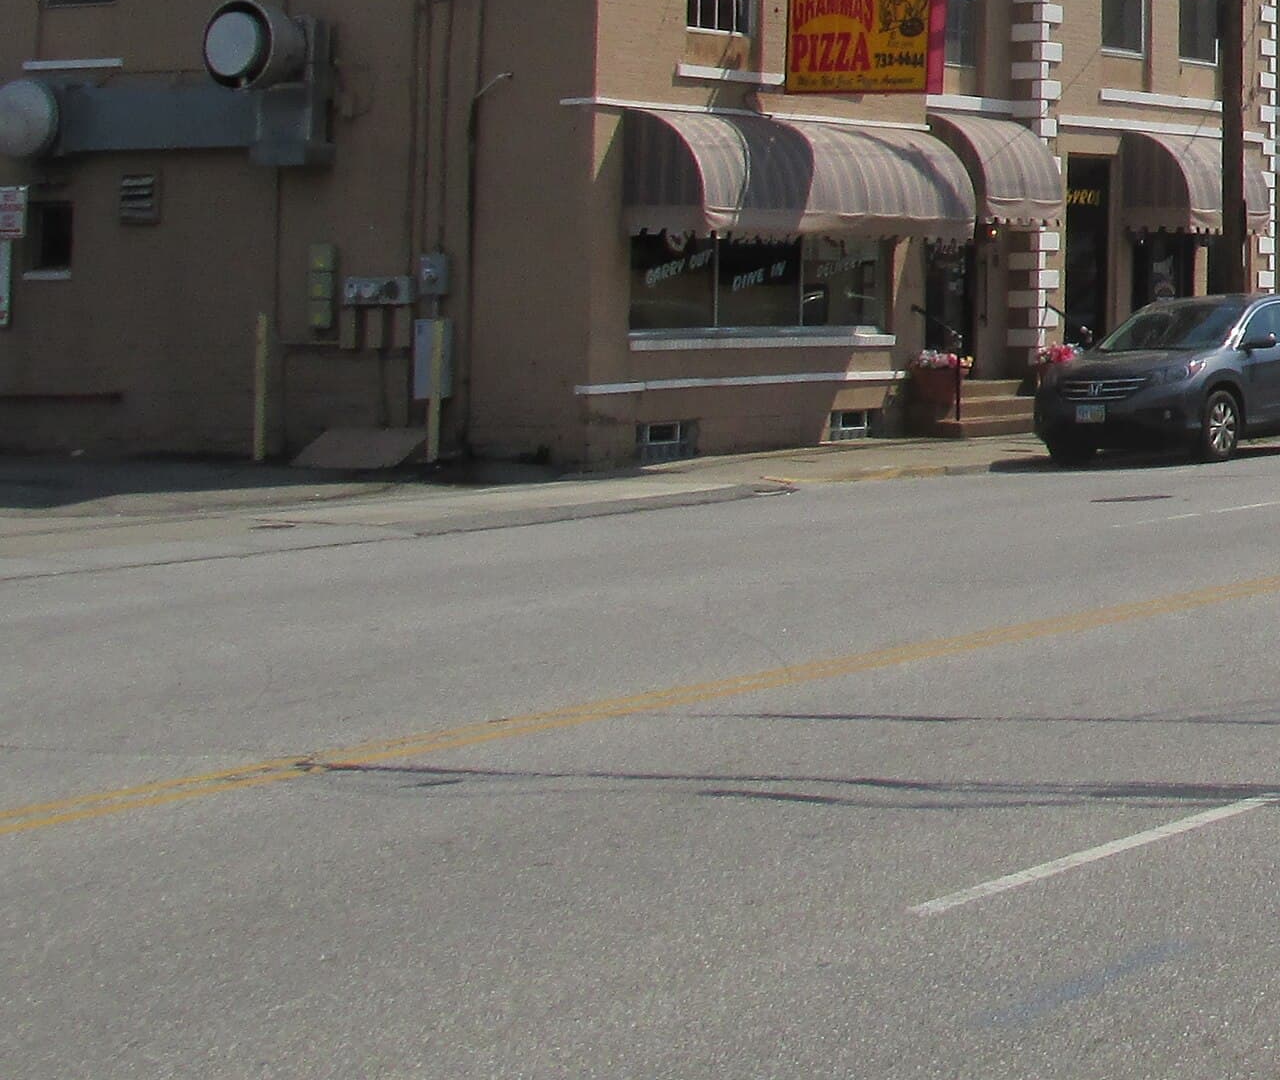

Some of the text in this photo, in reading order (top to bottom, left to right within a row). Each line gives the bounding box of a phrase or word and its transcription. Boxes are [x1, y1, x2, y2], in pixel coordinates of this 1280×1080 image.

[790, 31, 872, 73] PIZZA
[689, 248, 714, 270] OUT
[732, 260, 787, 291] DINE IN
